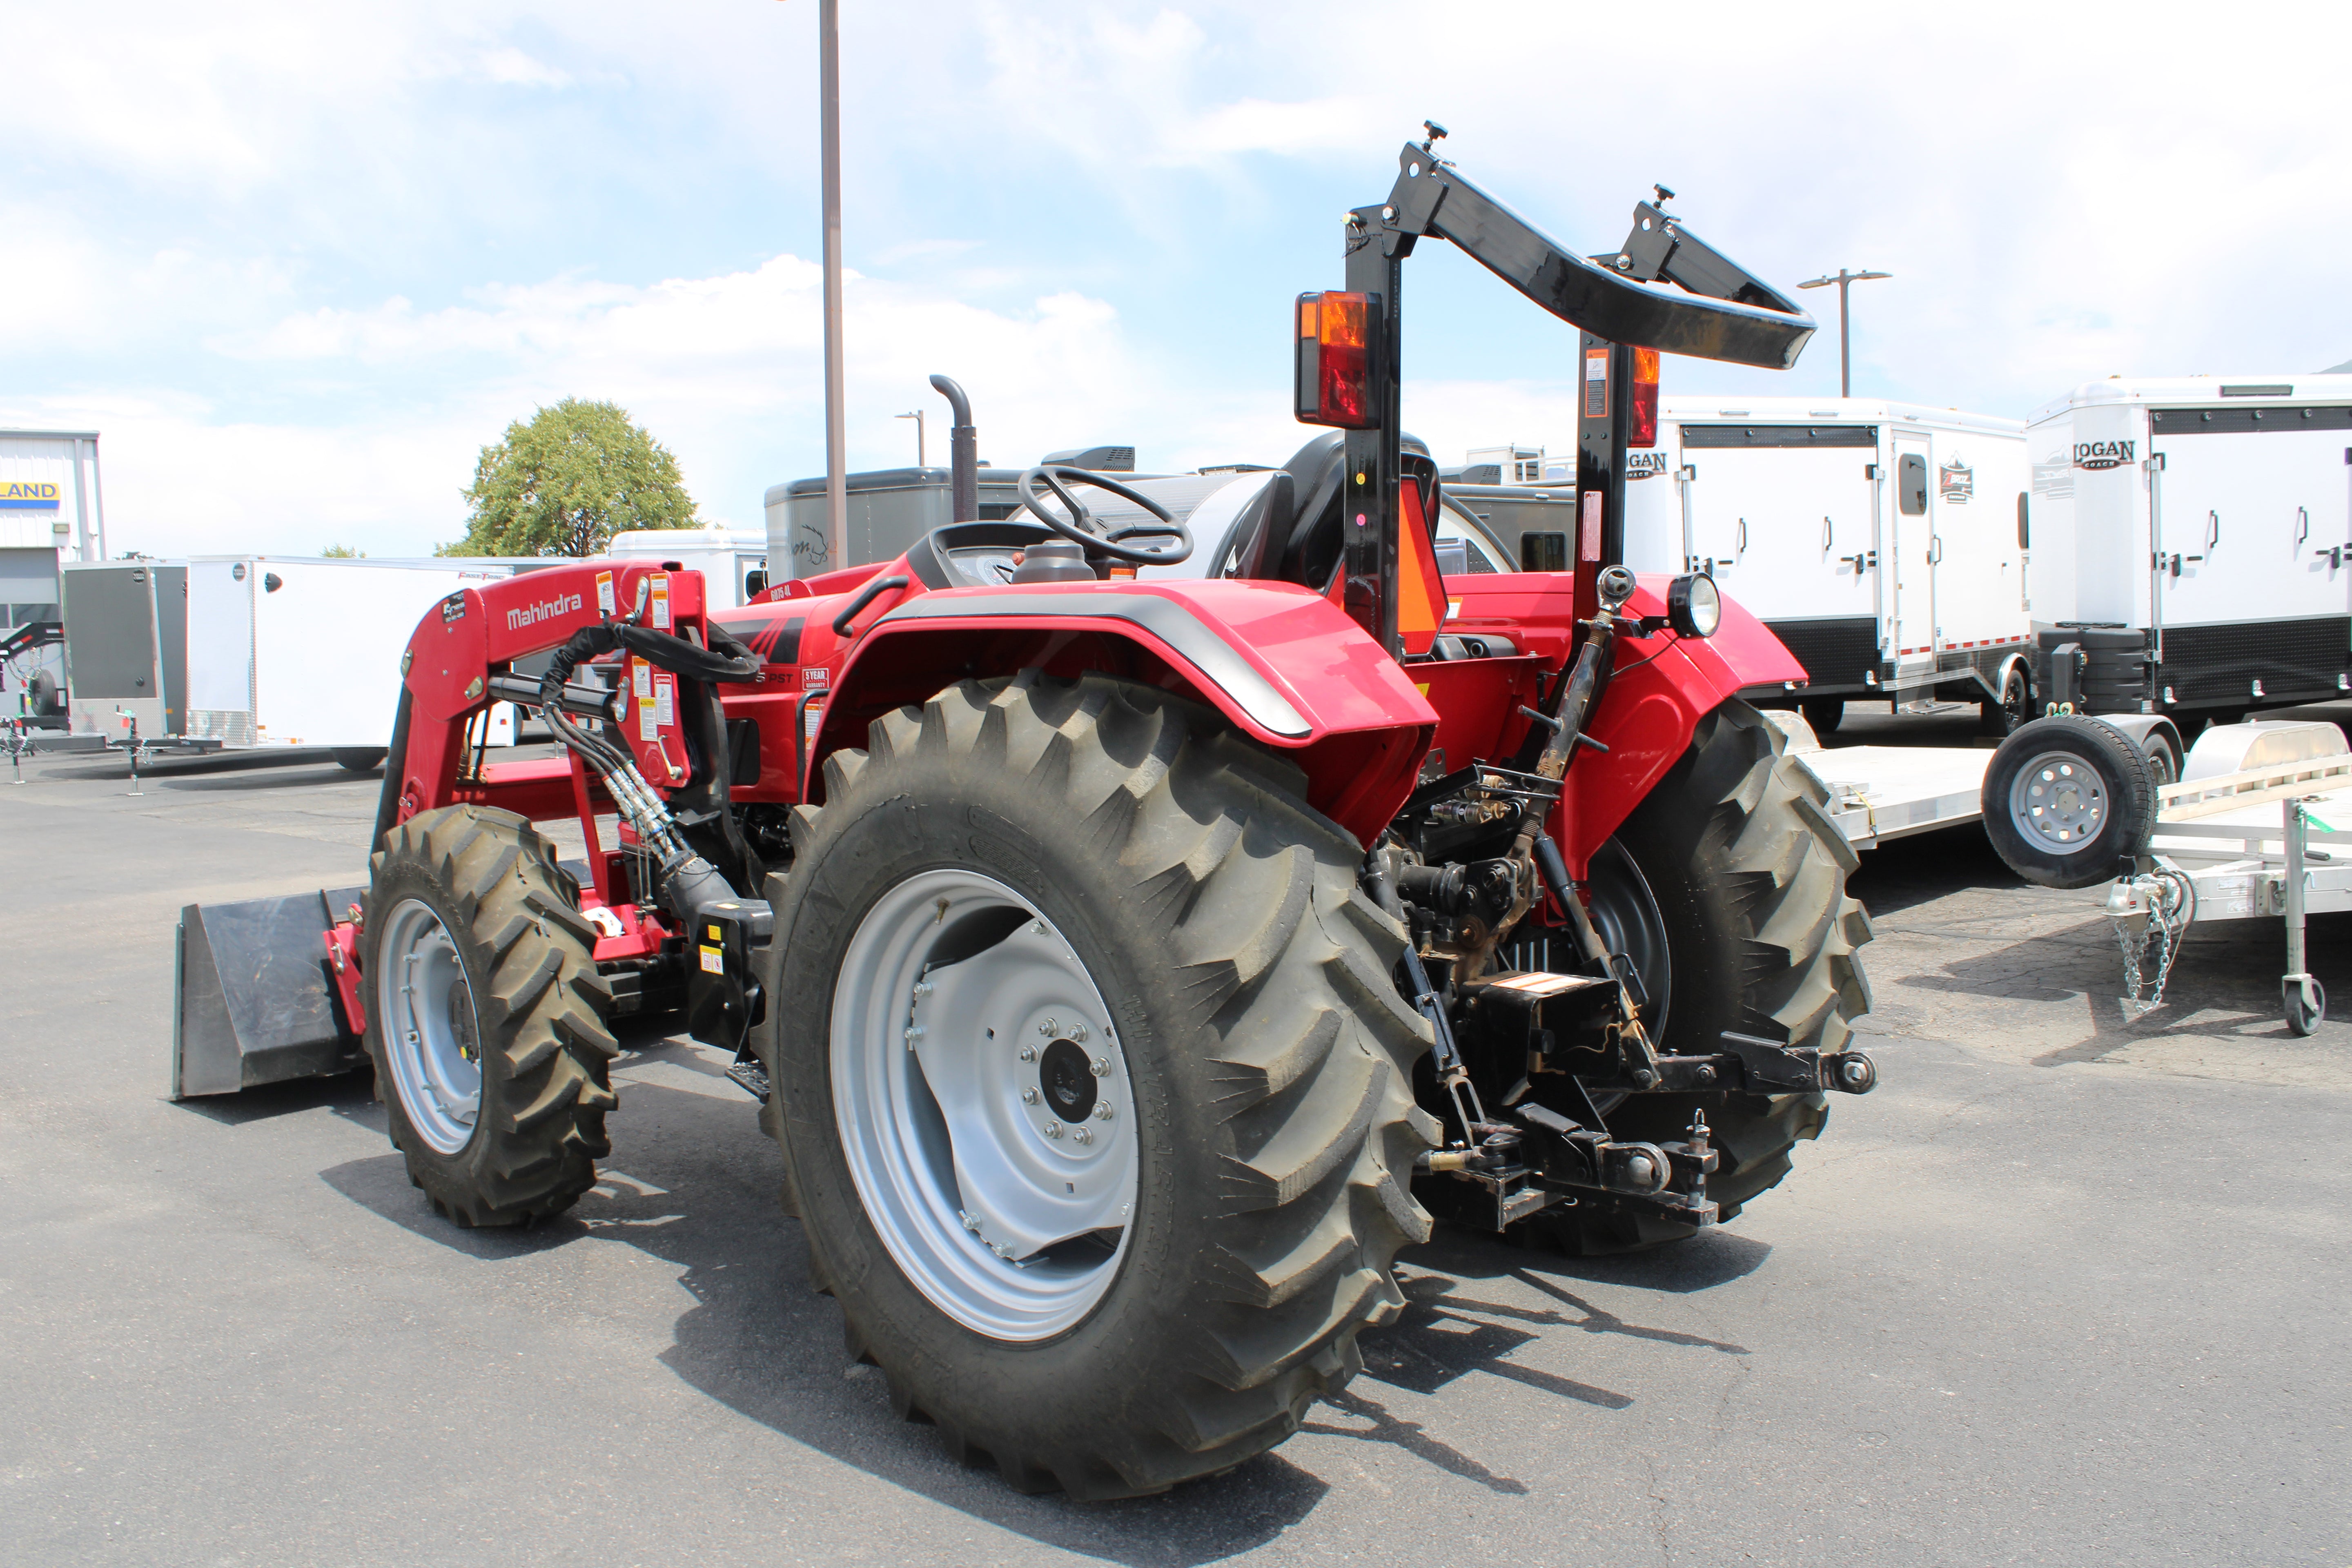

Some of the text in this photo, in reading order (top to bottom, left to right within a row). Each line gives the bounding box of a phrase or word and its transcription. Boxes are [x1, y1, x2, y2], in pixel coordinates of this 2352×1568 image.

[2073, 441, 2136, 463] LOGAN
[1626, 453, 1667, 472] GAN
[771, 587, 784, 601] 6075
[507, 593, 582, 630] Mahindra
[769, 674, 794, 683] PST
[805, 670, 825, 680] 5 YEAR
